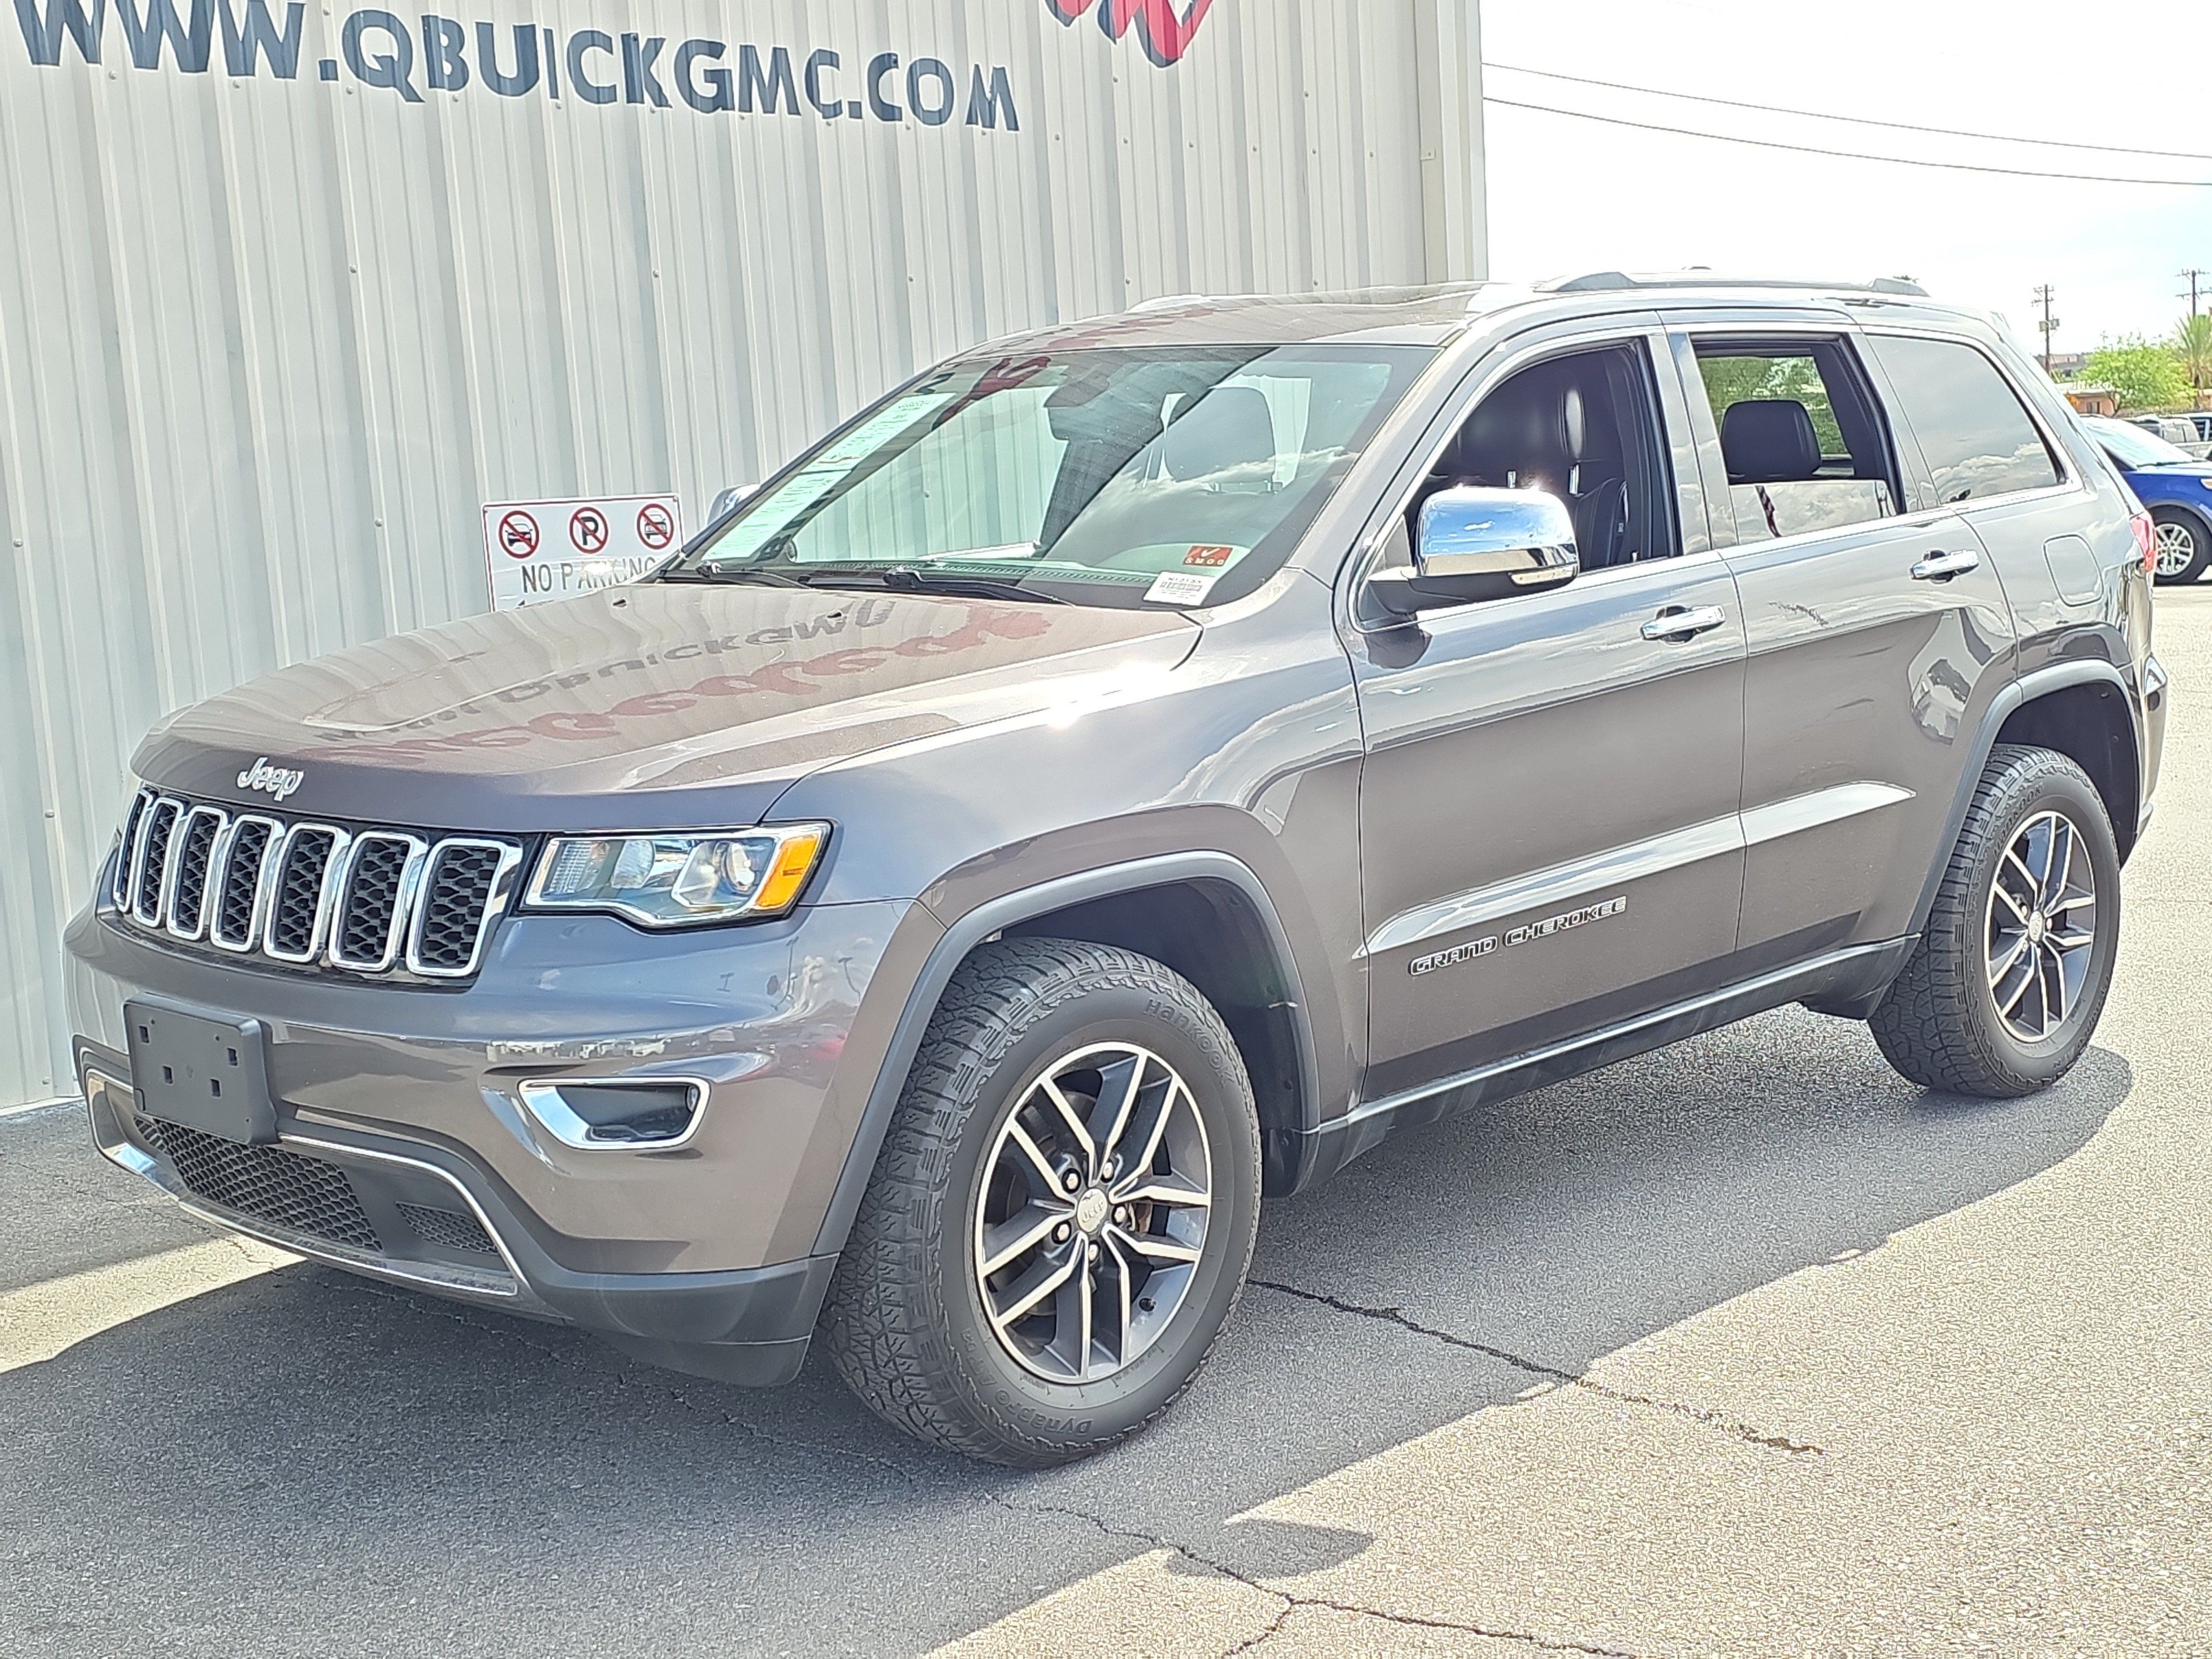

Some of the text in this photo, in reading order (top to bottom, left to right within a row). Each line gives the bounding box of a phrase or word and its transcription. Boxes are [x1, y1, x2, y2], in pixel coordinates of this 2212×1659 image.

[14, 0, 1020, 132] WWW.QBUICKGMC.COM
[521, 563, 552, 593] NO
[236, 756, 304, 802] Jeep
[1409, 896, 1627, 976] GRAND CHEROKEE
